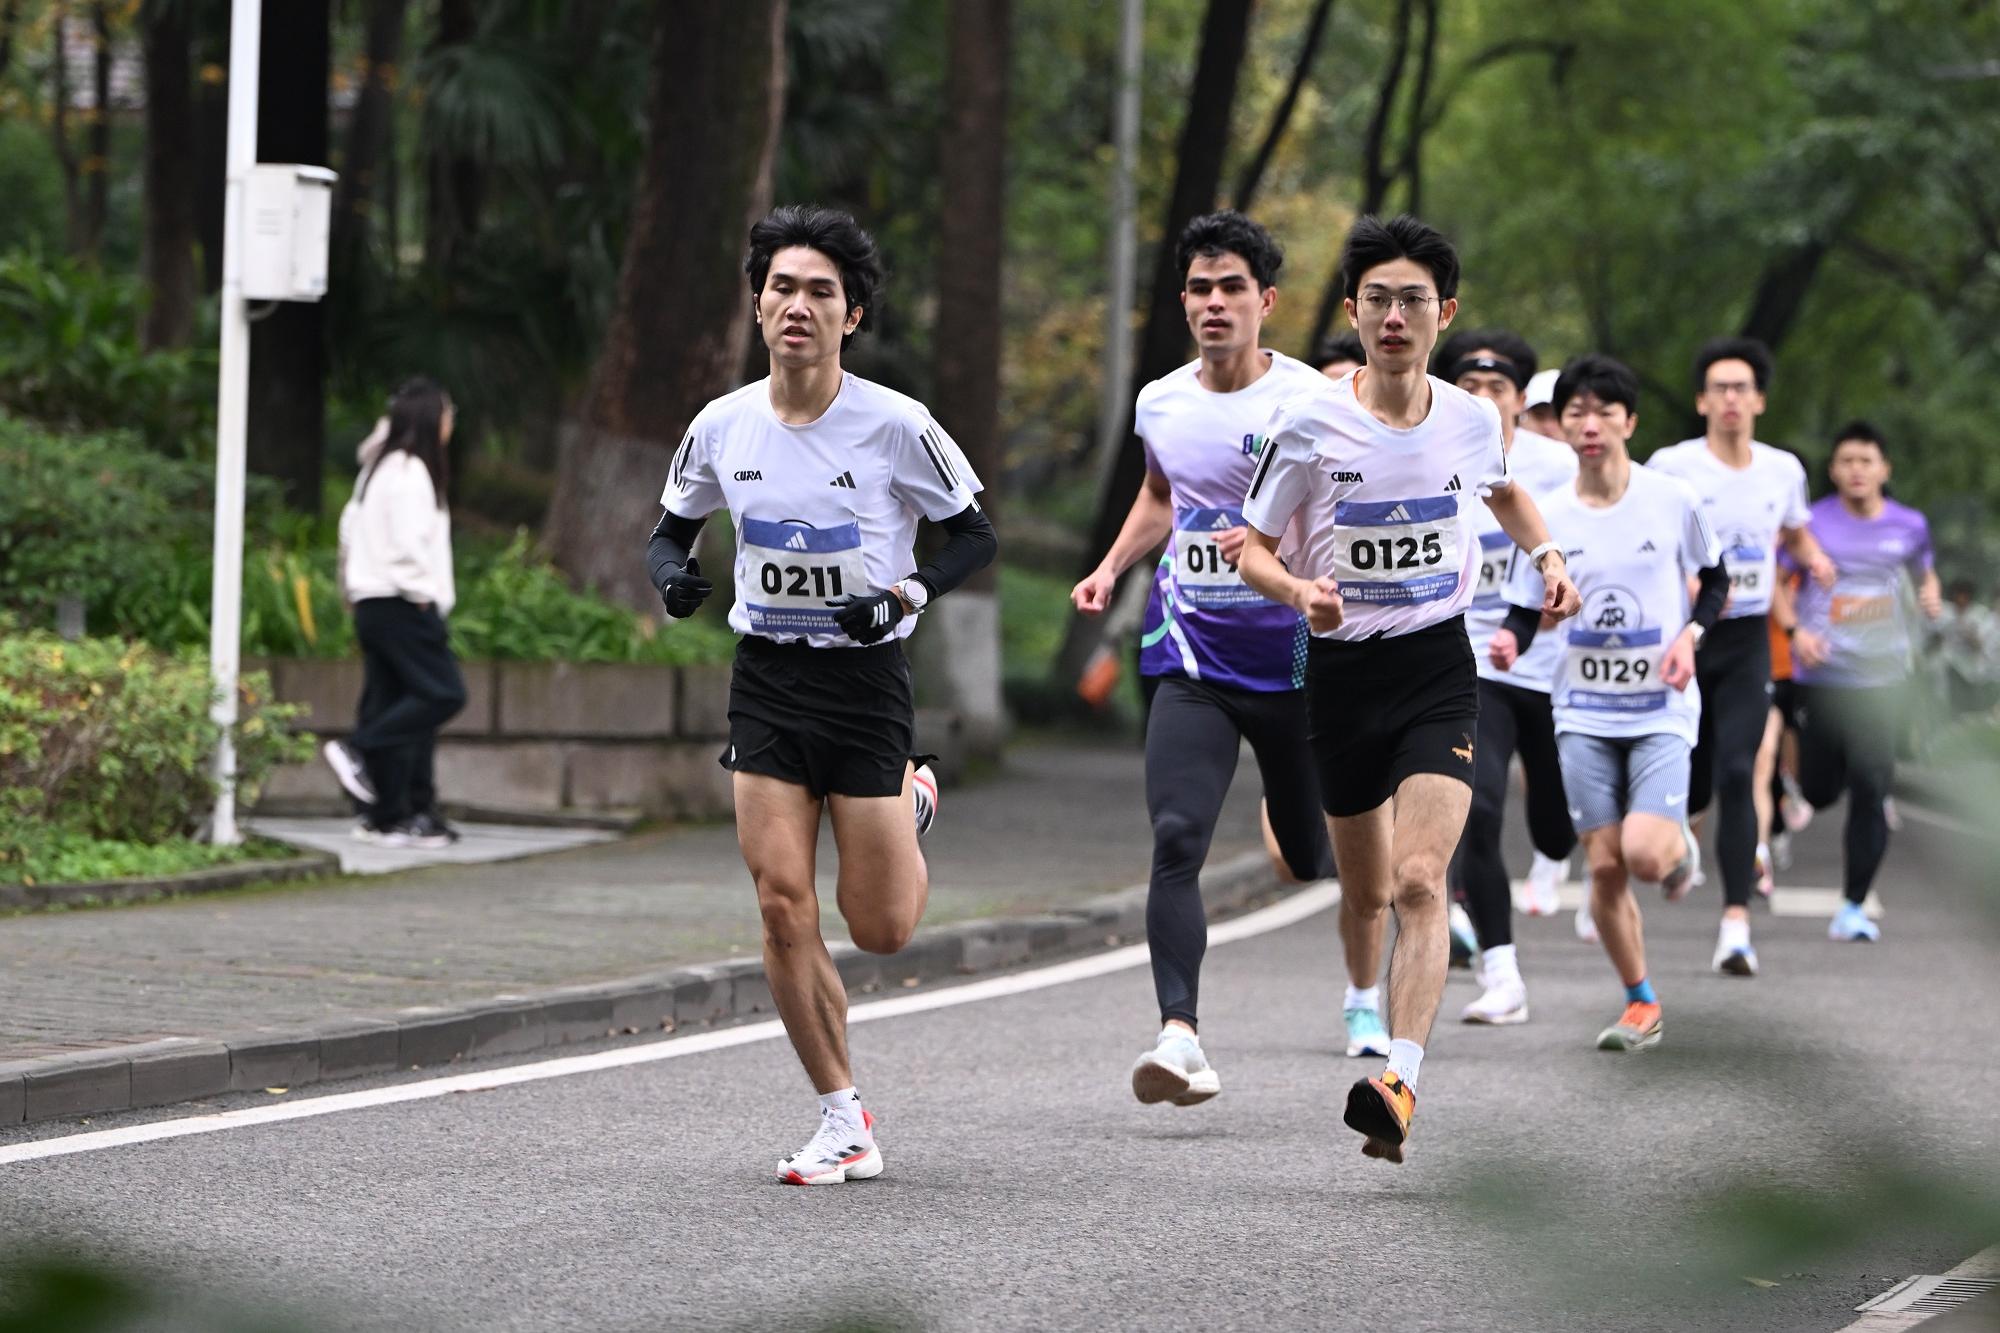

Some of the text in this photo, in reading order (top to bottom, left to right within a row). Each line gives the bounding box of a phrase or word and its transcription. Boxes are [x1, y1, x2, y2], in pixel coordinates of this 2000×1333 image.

[734, 470, 762, 481] CURA
[1331, 472, 1363, 483] CURA
[1188, 544, 1238, 573] 01
[1351, 533, 1442, 570] 0125
[761, 562, 842, 597] 0211
[1581, 656, 1650, 683] 0129
